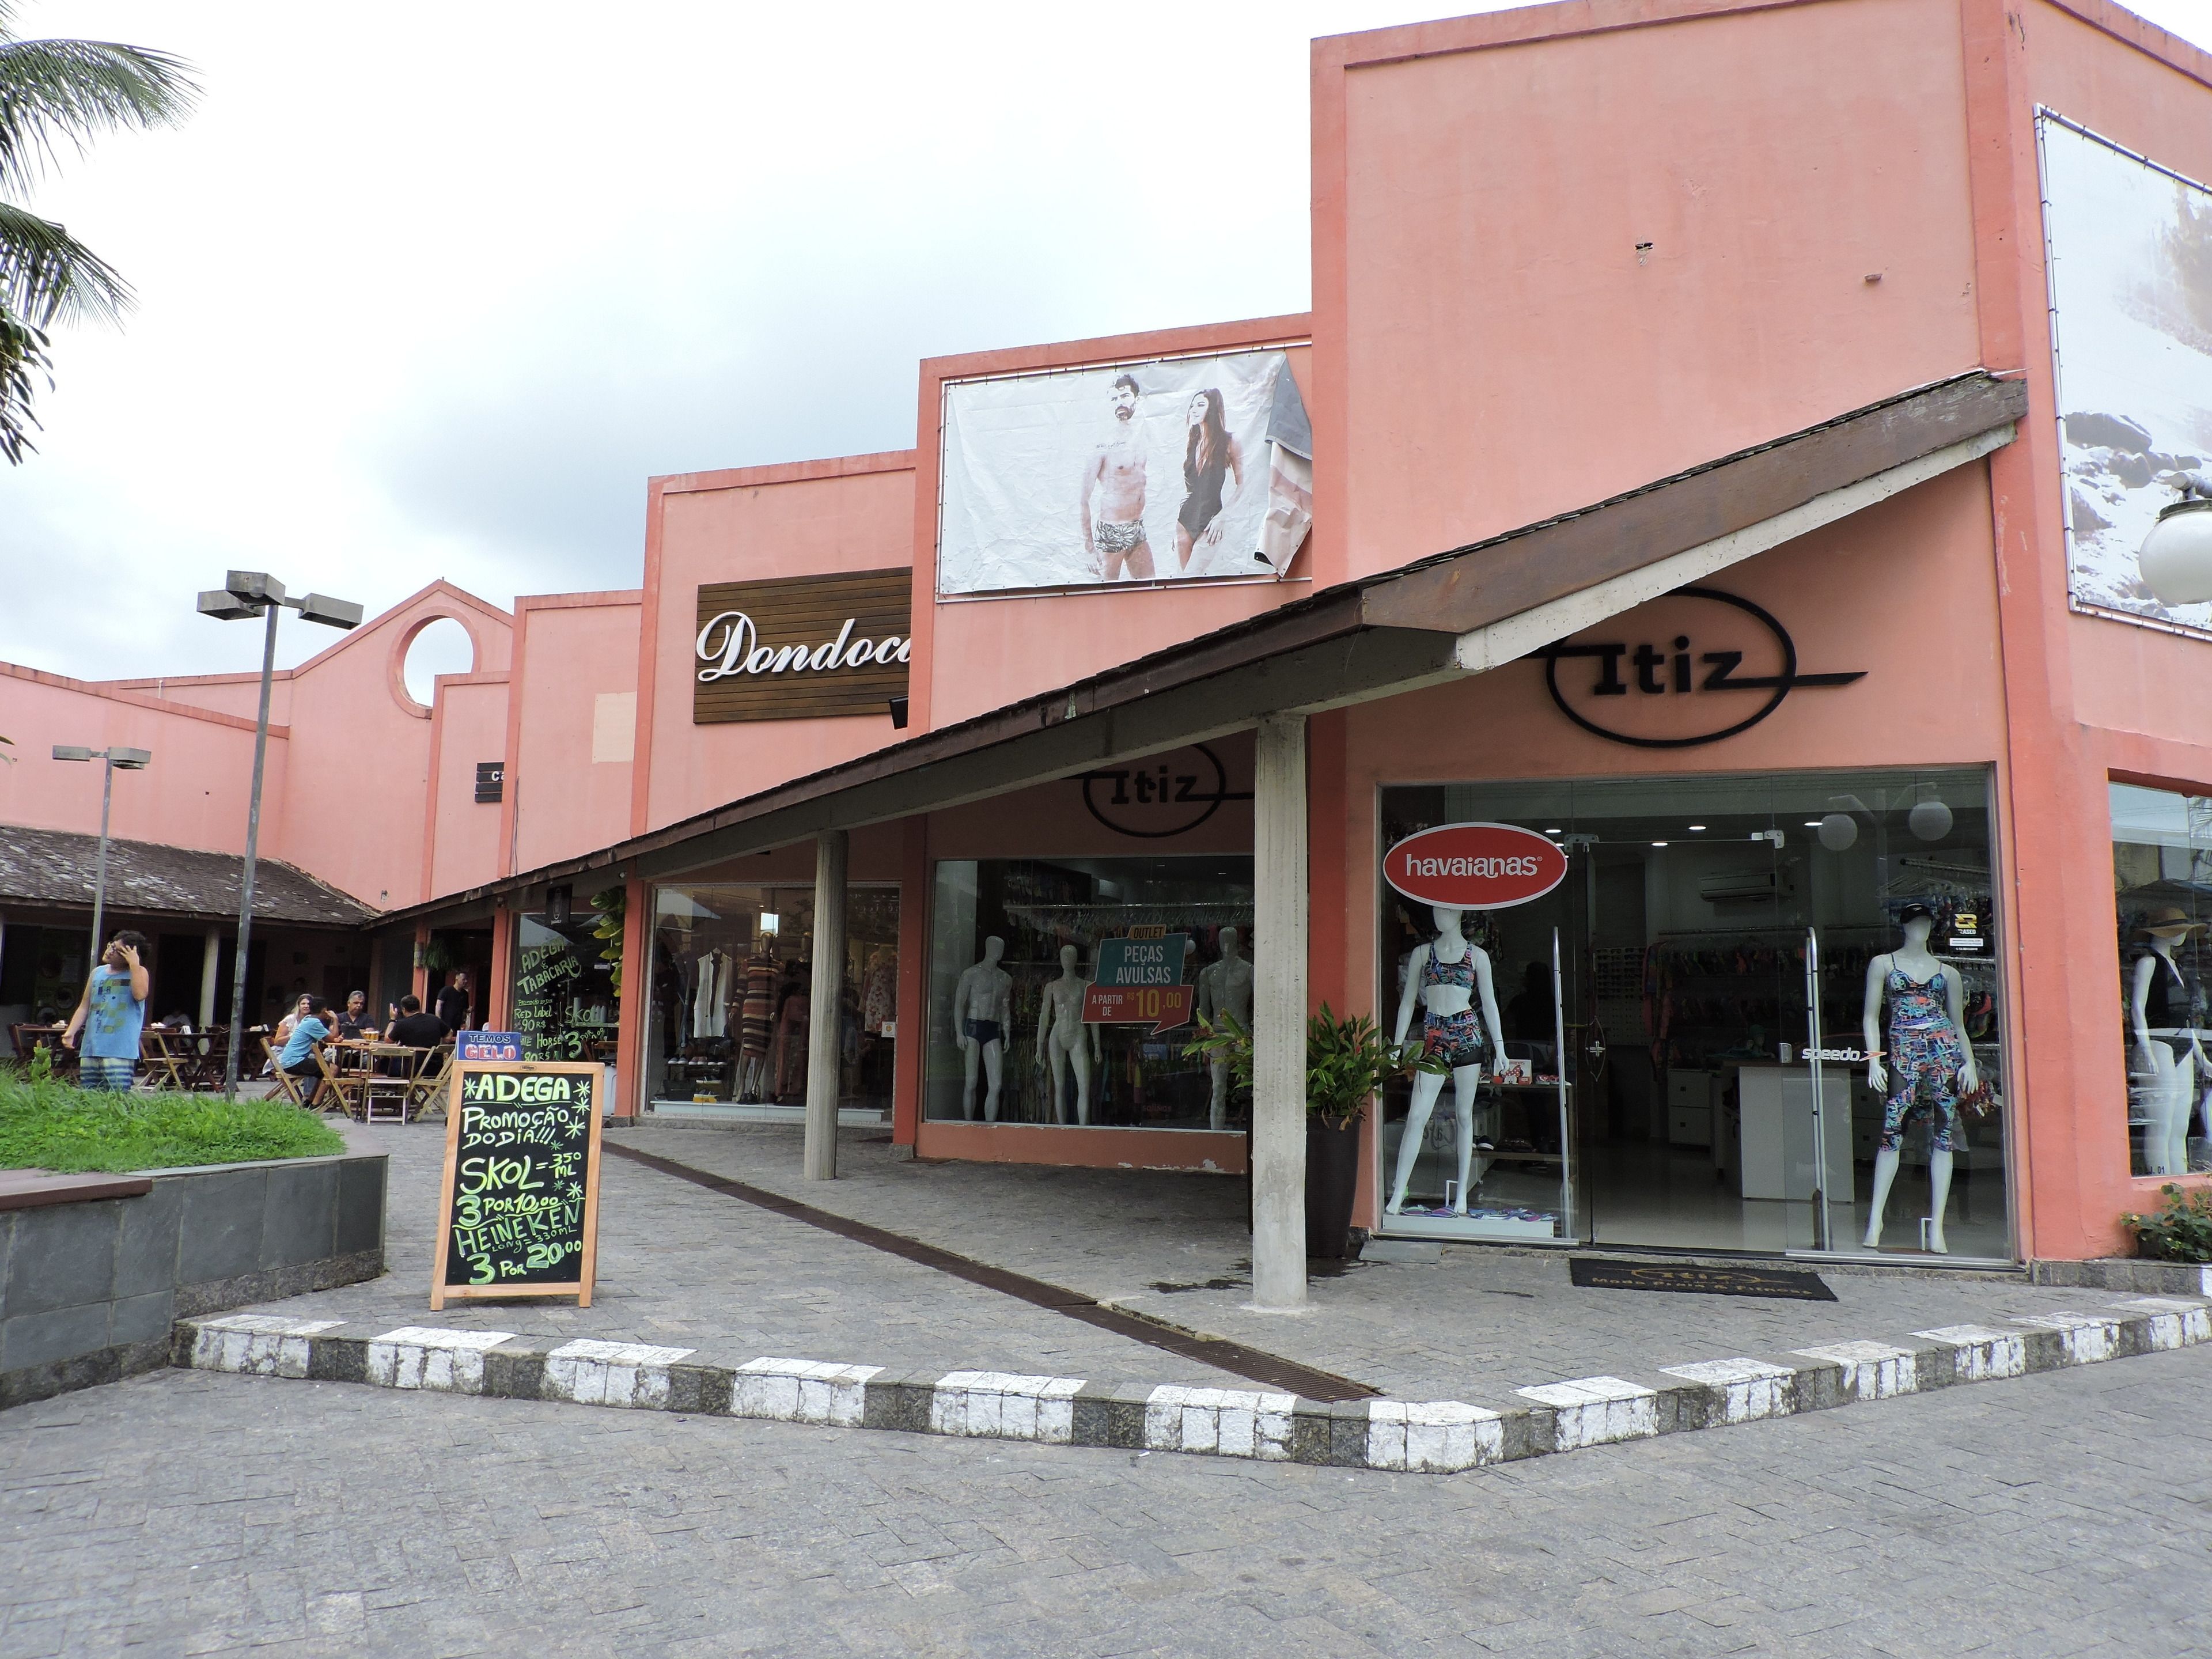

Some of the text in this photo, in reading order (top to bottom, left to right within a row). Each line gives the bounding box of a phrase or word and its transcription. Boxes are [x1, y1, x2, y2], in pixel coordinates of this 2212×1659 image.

[1406, 853, 1538, 878] havaianas
[1133, 926, 1164, 939] OUTLET
[521, 936, 565, 974] ADEGA
[1124, 945, 1164, 965] PEÇAS
[517, 956, 582, 995] TABACARIA
[1115, 967, 1171, 984] AVULSAS
[1092, 995, 1123, 1005] A PARTIR
[1103, 1006, 1112, 1016] DE
[521, 1019, 535, 1032] 90
[469, 1033, 511, 1044] TEMOS
[565, 1032, 582, 1059] 3
[465, 1043, 516, 1060] GELO
[1802, 1047, 1861, 1063] speedo
[475, 1074, 571, 1102] ADEGA
[461, 1105, 569, 1134] PROMOÇÃO
[460, 1155, 545, 1195] SKOL
[548, 1152, 582, 1169] 350
[456, 1194, 482, 1227] 3
[483, 1197, 514, 1216] POR
[454, 1200, 581, 1258] HEINEKEN
[467, 1252, 496, 1285] 3
[526, 1240, 582, 1269] 20,00
